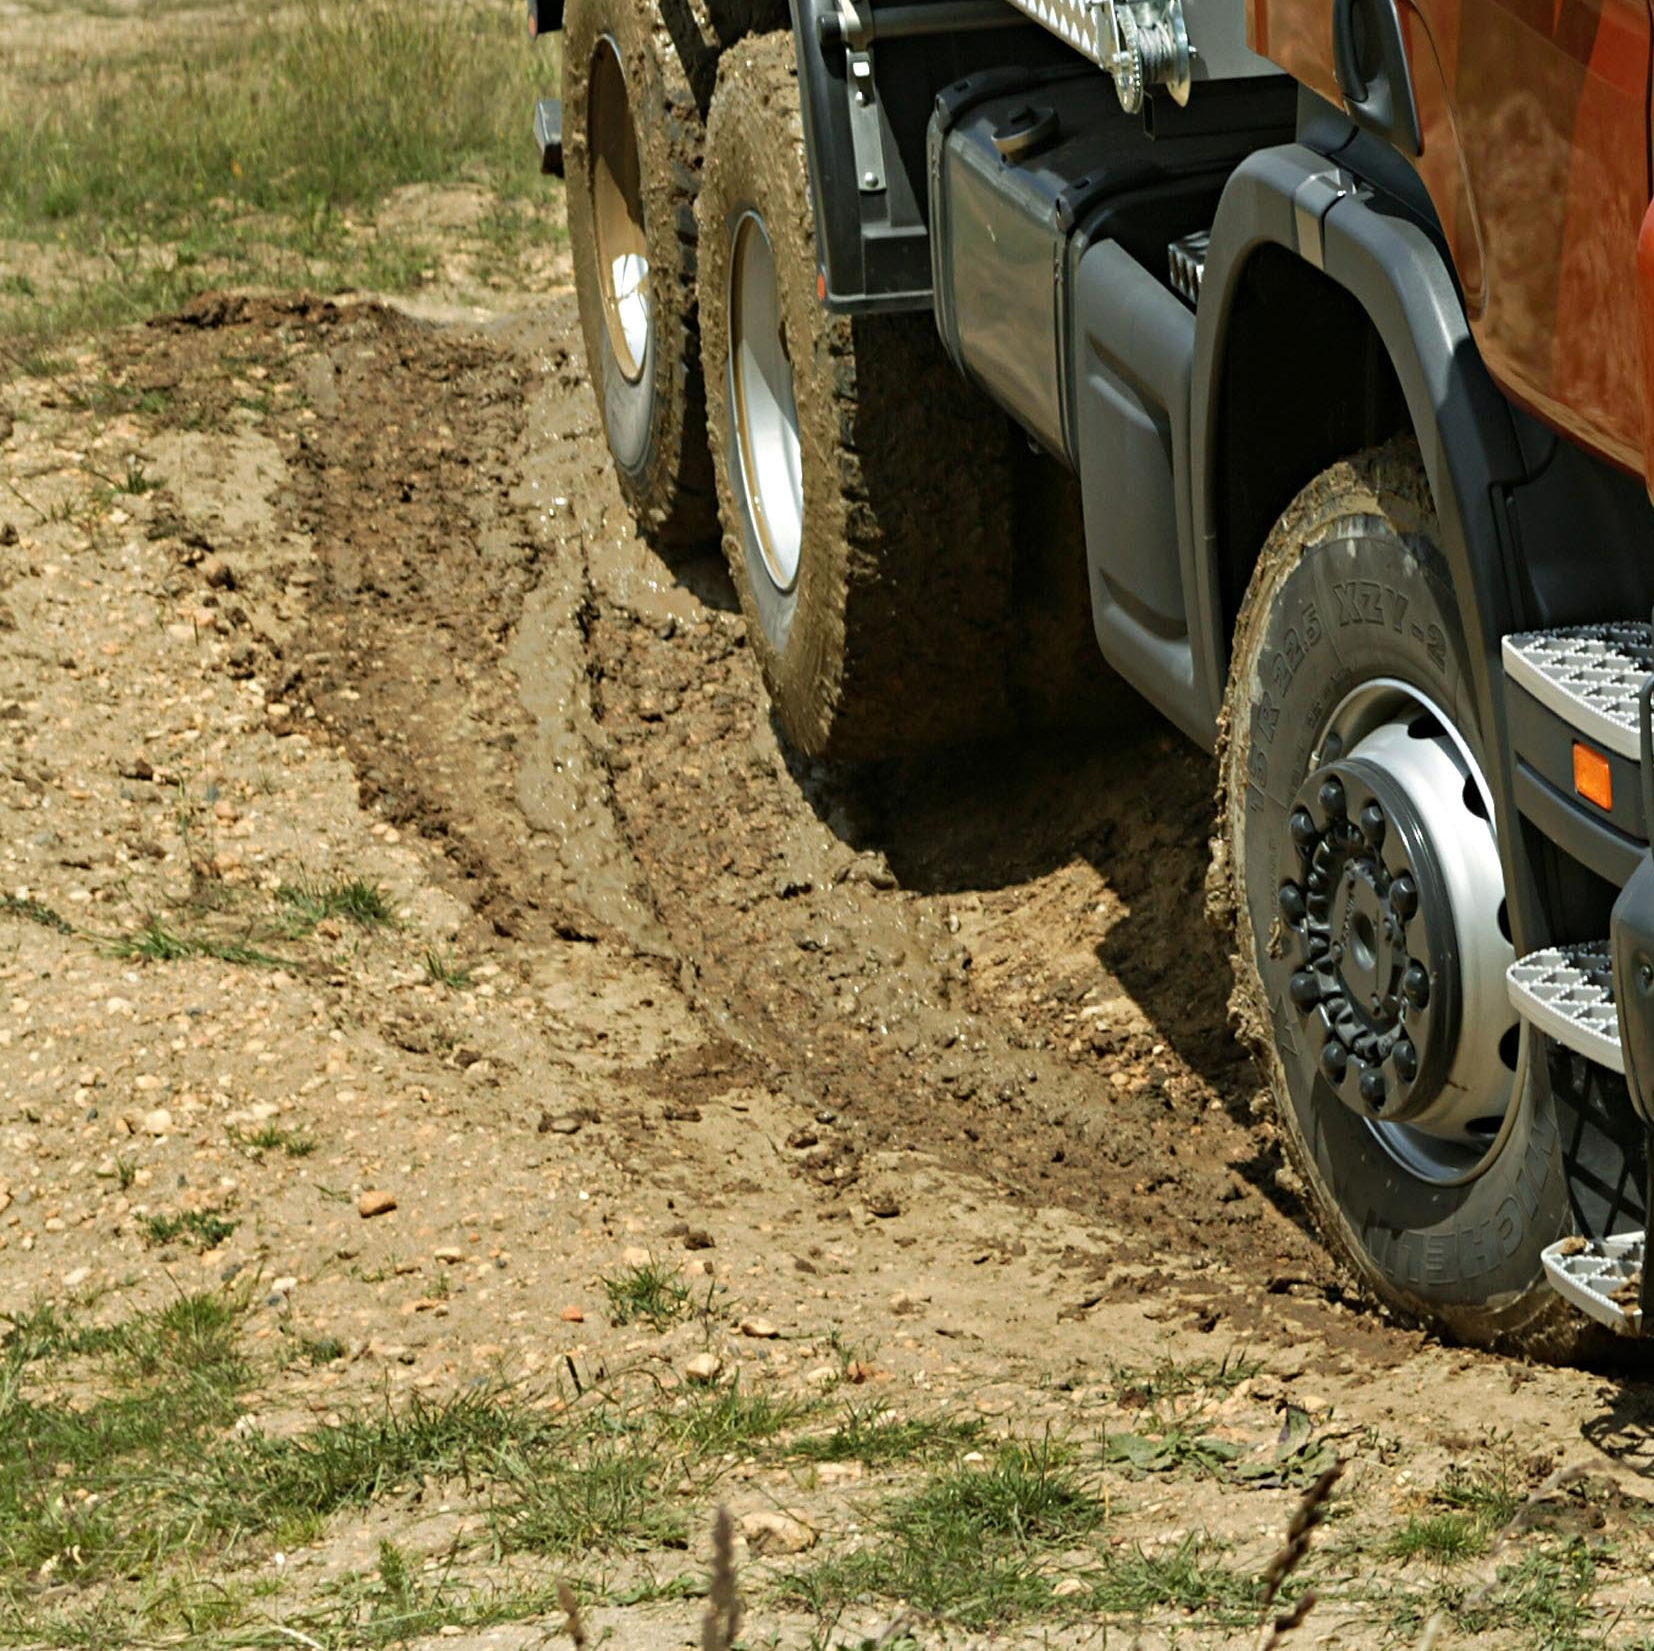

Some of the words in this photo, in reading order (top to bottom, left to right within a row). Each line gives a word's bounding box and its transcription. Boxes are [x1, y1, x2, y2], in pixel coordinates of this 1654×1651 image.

[1272, 601, 1323, 699] 22.5
[1331, 580, 1449, 674] XZY-2
[1361, 1102, 1562, 1287] MICHELIN
